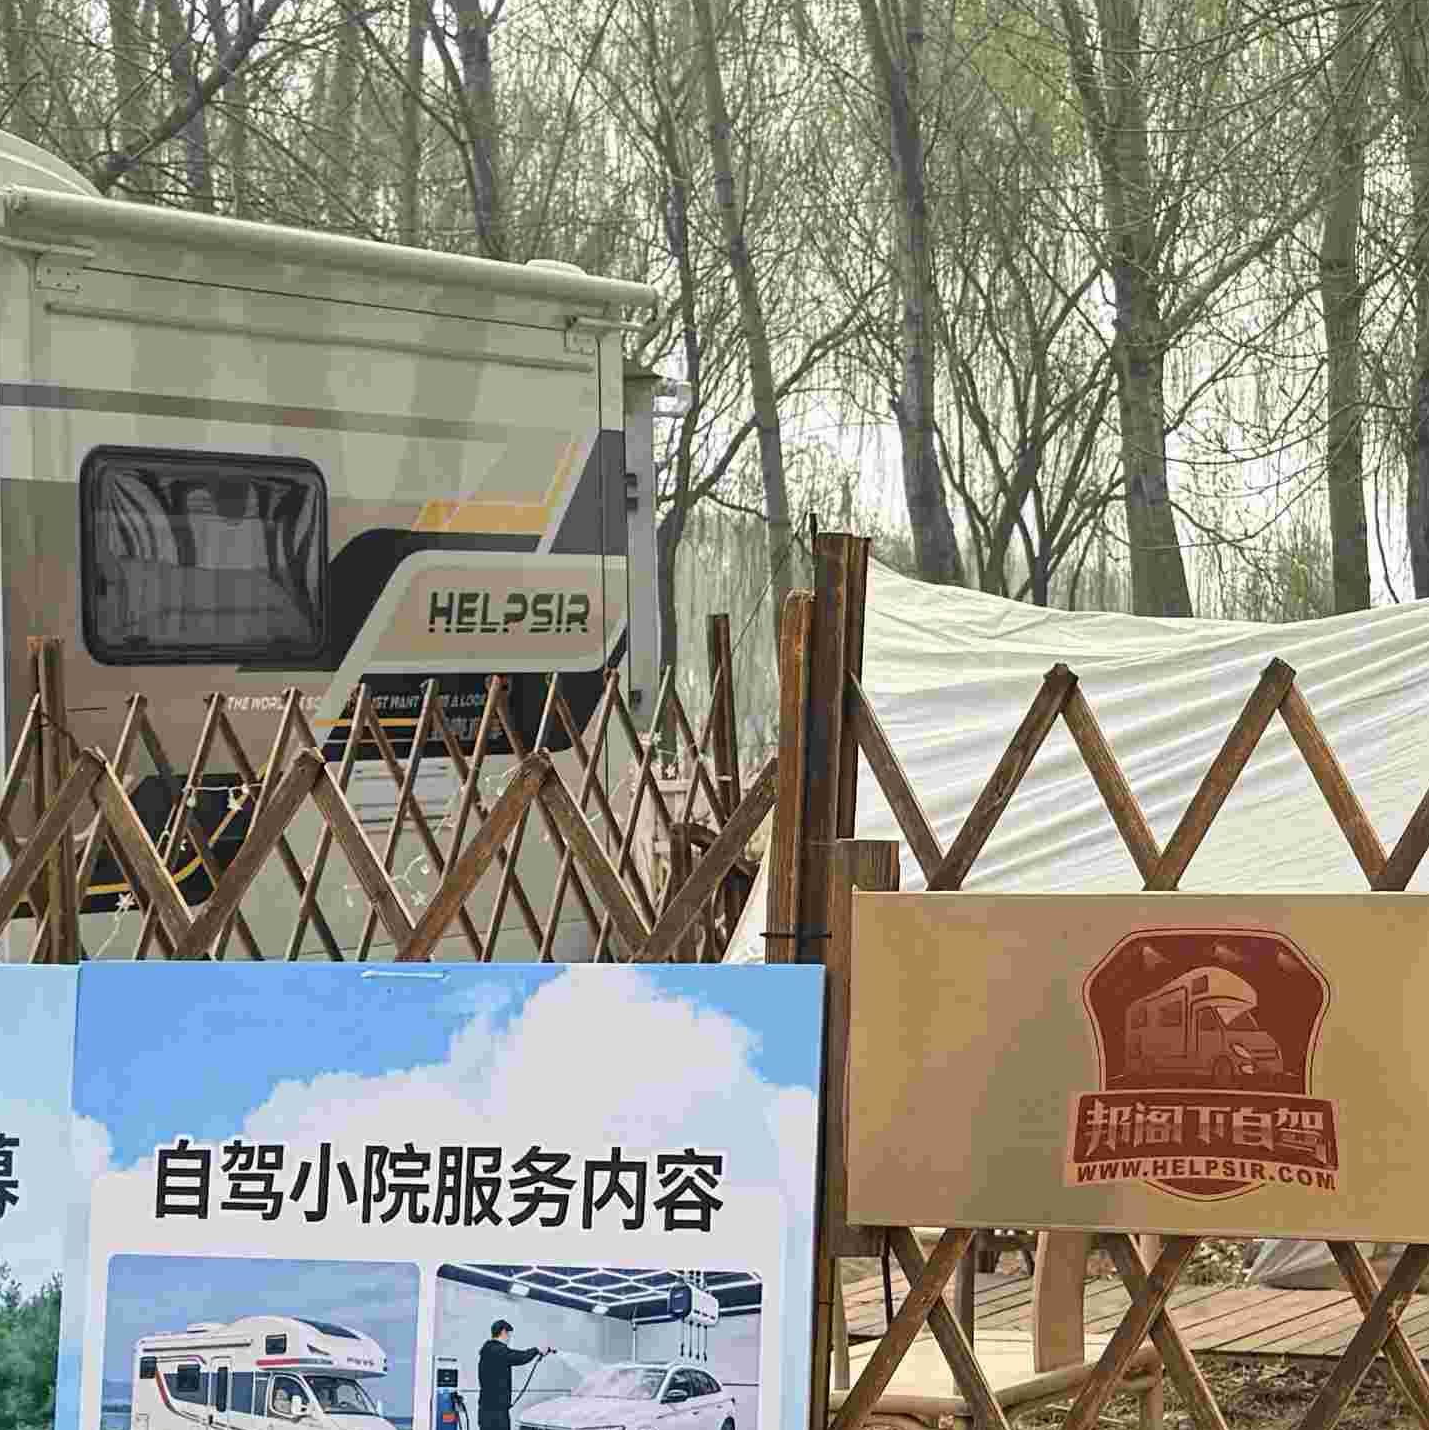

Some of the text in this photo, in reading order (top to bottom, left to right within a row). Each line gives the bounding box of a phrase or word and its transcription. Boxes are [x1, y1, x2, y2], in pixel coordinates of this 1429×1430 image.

[427, 591, 590, 634] HELPSIR
[1083, 1097, 1331, 1165] 邦阁下自驾
[154, 1137, 725, 1233] 自驾小院服务内容
[1077, 1158, 1336, 1191] WWW.HELPSIR.COM
